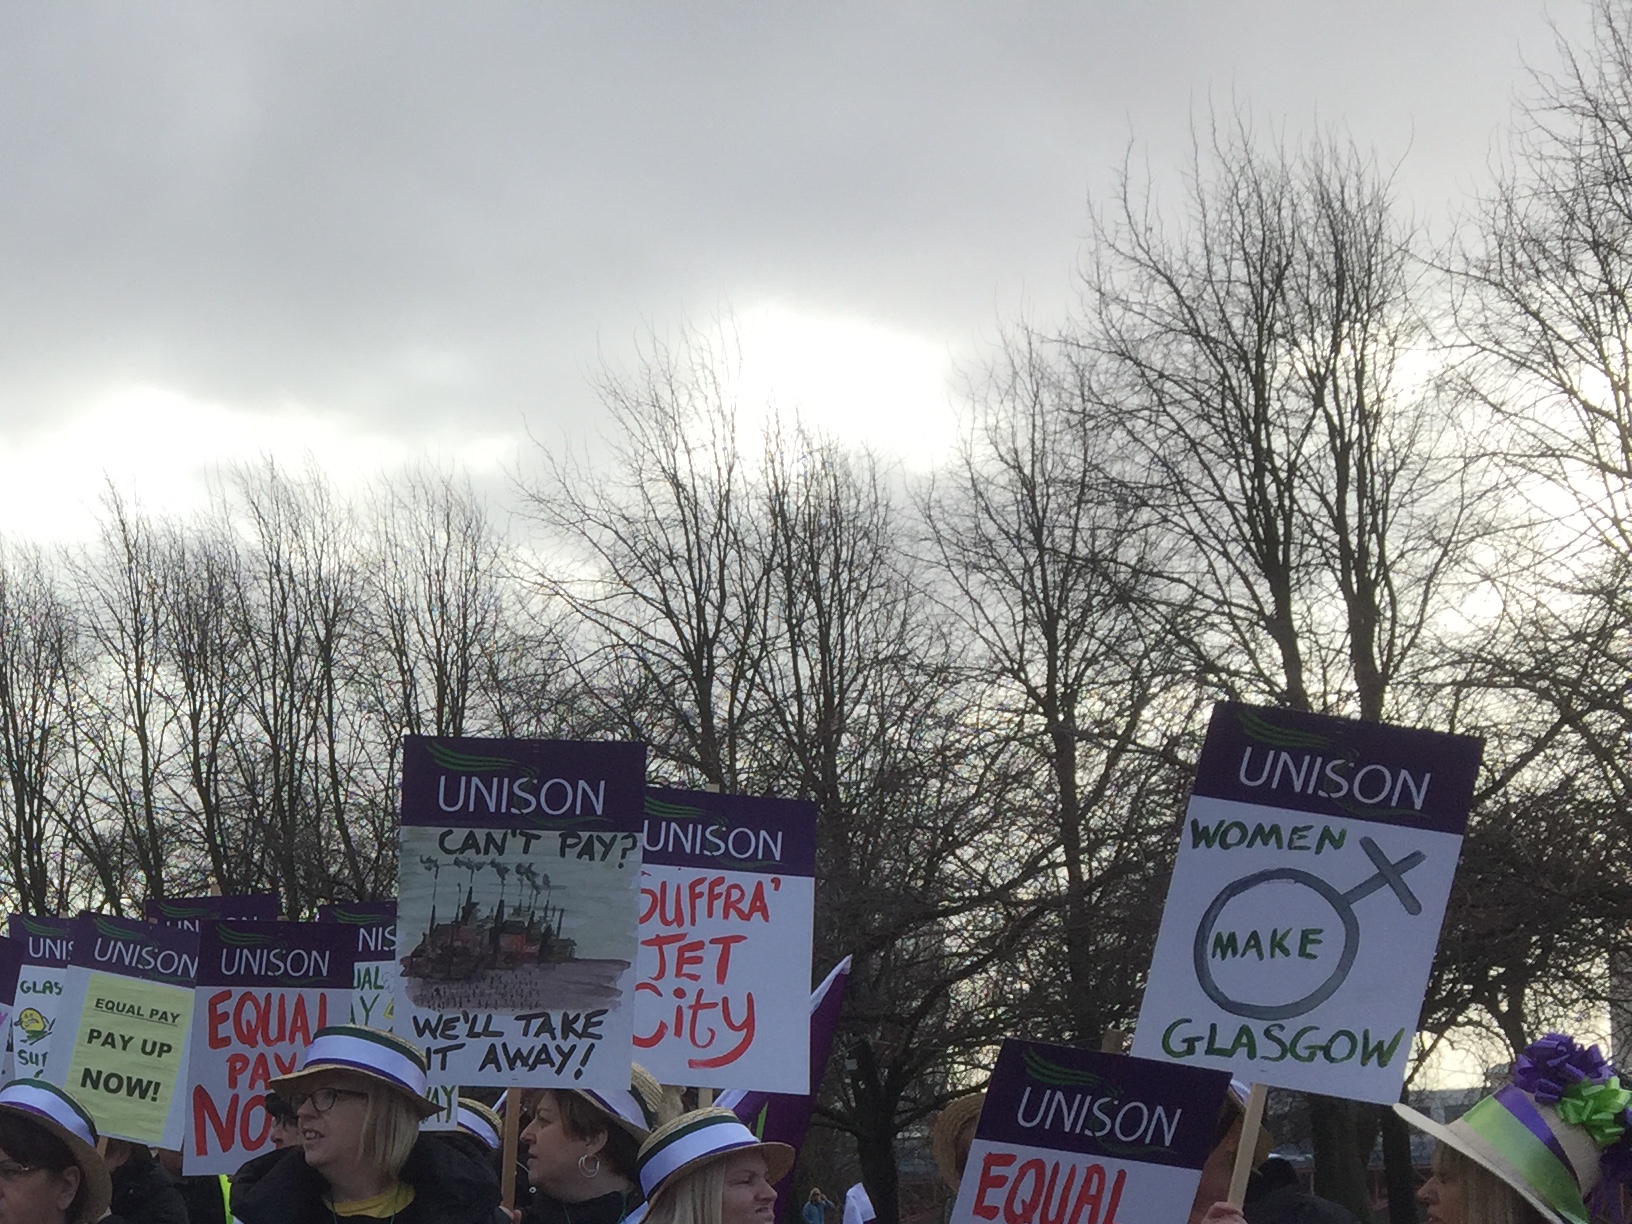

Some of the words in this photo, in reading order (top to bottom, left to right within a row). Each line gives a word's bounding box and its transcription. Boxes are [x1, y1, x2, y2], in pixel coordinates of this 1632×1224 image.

[438, 775, 606, 817] UNISON
[1240, 746, 1431, 810] UNISON
[438, 829, 542, 857] CAN'T
[559, 831, 638, 869] PAY?
[642, 819, 783, 861] UNISON
[1190, 818, 1347, 855] WOMEN
[93, 937, 199, 979] UNISON
[221, 947, 330, 977] UNISON
[640, 932, 748, 985] JET
[1211, 927, 1324, 961] MAKE
[94, 997, 145, 1018] EQUAL
[149, 1006, 181, 1025] PAY
[412, 1011, 504, 1041] WE'LL
[514, 1009, 609, 1042] TAKE
[86, 1029, 133, 1052] PAY
[140, 1038, 173, 1059] UP
[425, 1043, 467, 1071] IT
[479, 1041, 595, 1081] AWAY!
[1162, 1018, 1405, 1068] GLASGOW
[80, 1068, 162, 1102] NOW!
[193, 1084, 275, 1157] NO
[1017, 1086, 1182, 1147] UNISON
